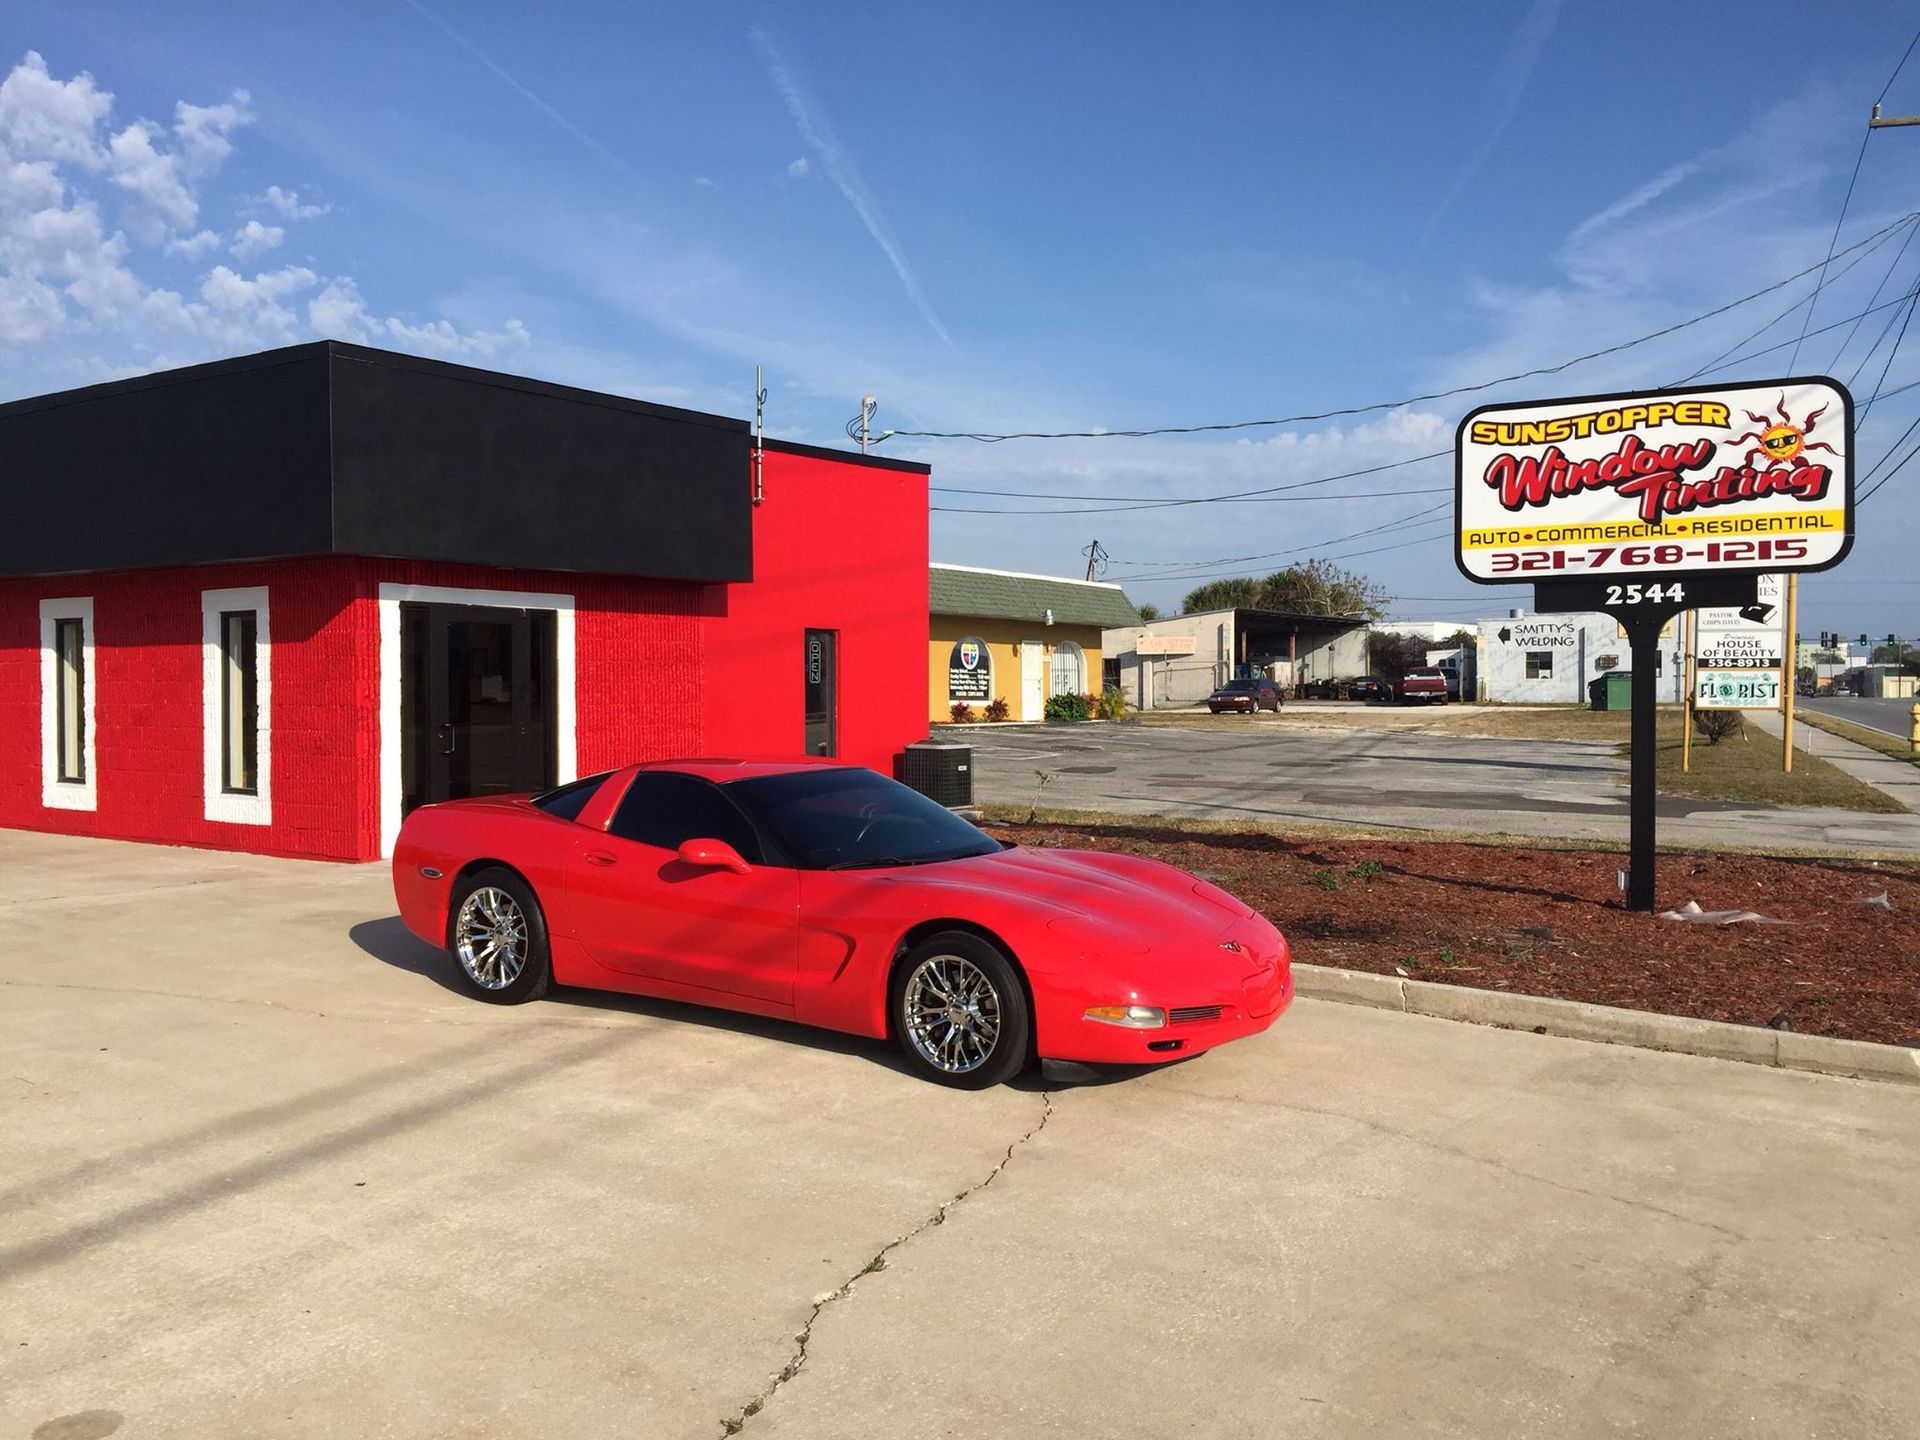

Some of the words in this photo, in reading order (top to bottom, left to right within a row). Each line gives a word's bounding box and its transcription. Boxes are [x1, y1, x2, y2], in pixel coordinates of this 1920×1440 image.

[1471, 401, 1731, 445] SUNSTOPPER
[1484, 434, 1716, 512] Window
[1615, 466, 1832, 524] Tinting
[1470, 532, 1520, 545] AUTO
[1536, 524, 1677, 541] COMMERCIAL
[1692, 515, 1834, 535] RESIDENTIAL
[1492, 539, 1808, 572] 321-768-1215
[1605, 583, 1685, 605] 2544
[1515, 623, 1575, 634] SMITTY'S
[1515, 636, 1575, 646] WELDING
[1716, 640, 1762, 649] HOUSE
[811, 644, 819, 680] OPEN
[1702, 649, 1720, 657] OF
[1723, 649, 1776, 657] BEAUTY
[1708, 659, 1770, 667] 536-8913
[1698, 682, 1779, 698] FLORIST
